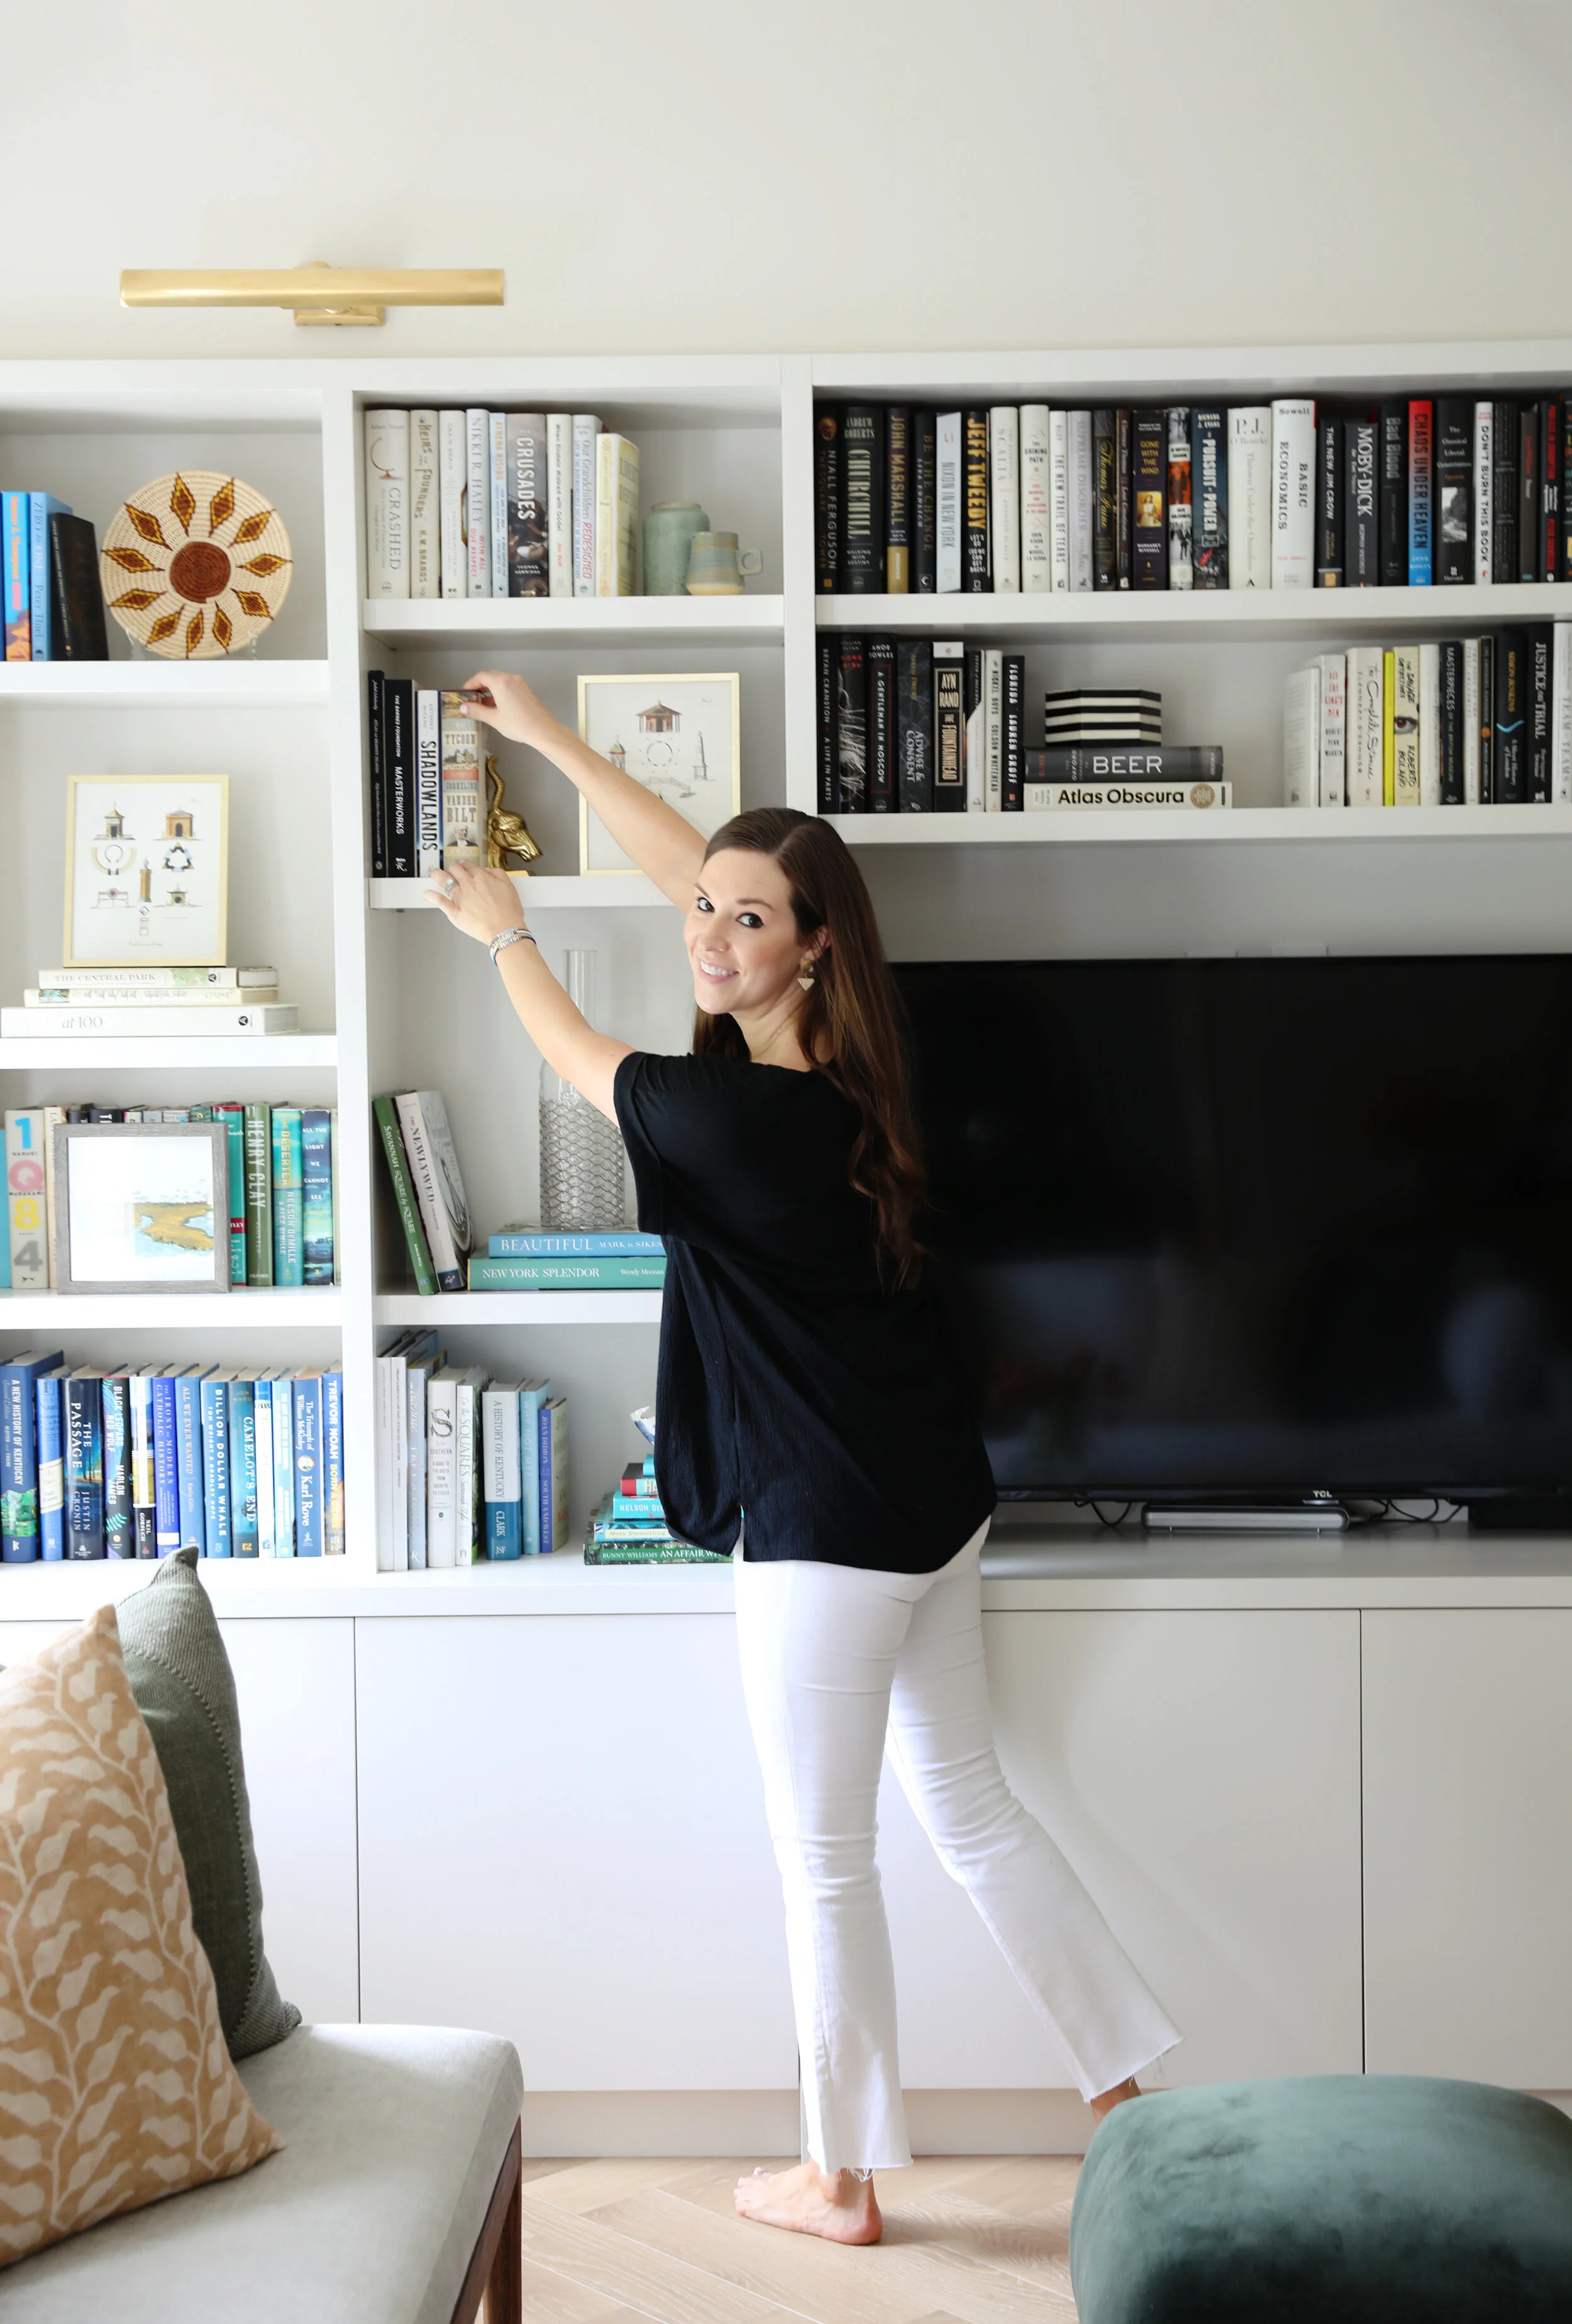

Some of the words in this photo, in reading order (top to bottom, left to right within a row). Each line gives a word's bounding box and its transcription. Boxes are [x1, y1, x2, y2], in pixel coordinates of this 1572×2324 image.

[418, 424, 432, 453] HEIRS
[891, 416, 904, 449] JOHN
[968, 418, 986, 458] JEFF
[1140, 440, 1160, 448] GONE
[1326, 426, 1334, 445] THE
[1386, 417, 1401, 440] Bad
[1414, 413, 1428, 453] CHAOS
[828, 450, 836, 489] NIALL
[1055, 455, 1064, 464] THE
[1203, 439, 1216, 487] PURSUIT
[1326, 447, 1334, 470] NEW
[1358, 428, 1373, 517] MOBY-DICK
[1386, 444, 1401, 479] Blood
[517, 437, 536, 519] CRUSADES
[892, 455, 904, 526] MARSHALL
[941, 462, 955, 489] NIXON
[1056, 473, 1065, 490] NEW
[1278, 441, 1289, 529] ECONOMICS
[1298, 463, 1308, 507] BASIC
[1326, 472, 1334, 488] JIM
[1414, 457, 1428, 499] UNDER
[415, 468, 433, 518] FOUNDERS
[848, 449, 870, 540] CHURCHILL
[941, 492, 955, 501] IN
[968, 463, 986, 529] TWEEDY
[1056, 495, 1065, 520] TRAIL
[1326, 490, 1334, 519] CROW
[941, 504, 955, 523] NEW
[1204, 493, 1217, 531] POWER
[1414, 503, 1428, 548] HEAVEN
[389, 487, 402, 570] CRASHED
[828, 497, 837, 568] FERGUSON
[941, 526, 955, 548] YORK
[1056, 524, 1065, 533] OF
[1056, 537, 1065, 563] TEARS
[1481, 529, 1489, 562] BOOK
[419, 549, 428, 582] BRANDS
[941, 673, 956, 690] AYN
[991, 670, 999, 694] NICKEL
[1329, 671, 1338, 680] ALL
[1536, 642, 1546, 690] JUSTICE
[939, 692, 959, 707] RAND
[1009, 664, 1018, 704] FLORIDA
[1407, 673, 1415, 704] SAVAGE
[1009, 714, 1017, 750] LAUREN
[1536, 702, 1546, 739] TRIAL
[445, 733, 475, 745] TYCOON
[878, 733, 885, 741] IN
[915, 731, 924, 769] ADVISE
[942, 724, 957, 780] FOUNTAINHEAD
[905, 730, 916, 782] CONSENT
[1009, 754, 1017, 783] GROFF
[1093, 756, 1162, 773] BEER
[1407, 745, 1416, 787] ROBERTO
[915, 773, 925, 782] &
[395, 766, 404, 834] MASTERWORKS
[421, 741, 437, 851] SHADOWLANDS
[1058, 788, 1103, 804] Atlas
[1107, 788, 1184, 804] Obscura
[15, 1117, 31, 1149] 1
[247, 1120, 265, 1166] HENRY
[280, 1130, 291, 1186] DESERTER
[411, 1128, 435, 1202] NEWLYWED
[9, 1159, 43, 1192] Q
[249, 1173, 265, 1207] CLAY
[383, 1126, 399, 1167] SAVANNAH
[394, 1170, 406, 1197] SQUARE
[403, 1206, 415, 1233] SQUARE
[14, 1198, 40, 1230] 8
[13, 1240, 43, 1271] 4
[501, 1238, 593, 1251] BEAUTIFUL
[483, 1269, 507, 1278] NEW
[509, 1268, 539, 1278] YORK
[543, 1268, 600, 1278] SPLENDOR
[13, 1386, 21, 1403] NEW
[113, 1386, 123, 1410] BLACK
[184, 1403, 191, 1416] WE
[328, 1380, 338, 1424] TREVOR
[13, 1405, 21, 1435] HISTORY
[106, 1415, 114, 1430] RED
[114, 1412, 124, 1446] LEOPARD
[215, 1389, 223, 1437] BILLION
[305, 1415, 314, 1442] Triumph
[494, 1408, 502, 1441] HISTORY
[14, 1437, 21, 1446] OF
[71, 1402, 82, 1468] PASSAGE
[83, 1422, 91, 1447] THE
[106, 1432, 115, 1452] WOLF
[295, 1420, 304, 1451] McKinley
[329, 1428, 338, 1459] NOAH
[495, 1444, 503, 1454] OF
[14, 1448, 23, 1485] KENTUCKY
[185, 1441, 193, 1474] WANTED
[216, 1442, 224, 1489] DOLLAR
[244, 1417, 255, 1491] CAMELOT'S
[108, 1480, 117, 1504] JAMES
[116, 1465, 125, 1495] MARLON
[302, 1475, 313, 1498] Karl
[330, 1464, 338, 1490] BORN
[495, 1456, 504, 1498] KENTUCKY
[82, 1491, 91, 1530] JUSTIN
[218, 1495, 226, 1536] WHALE
[246, 1495, 256, 1522] END
[302, 1501, 313, 1526] Rove
[495, 1510, 506, 1536] CLARK
